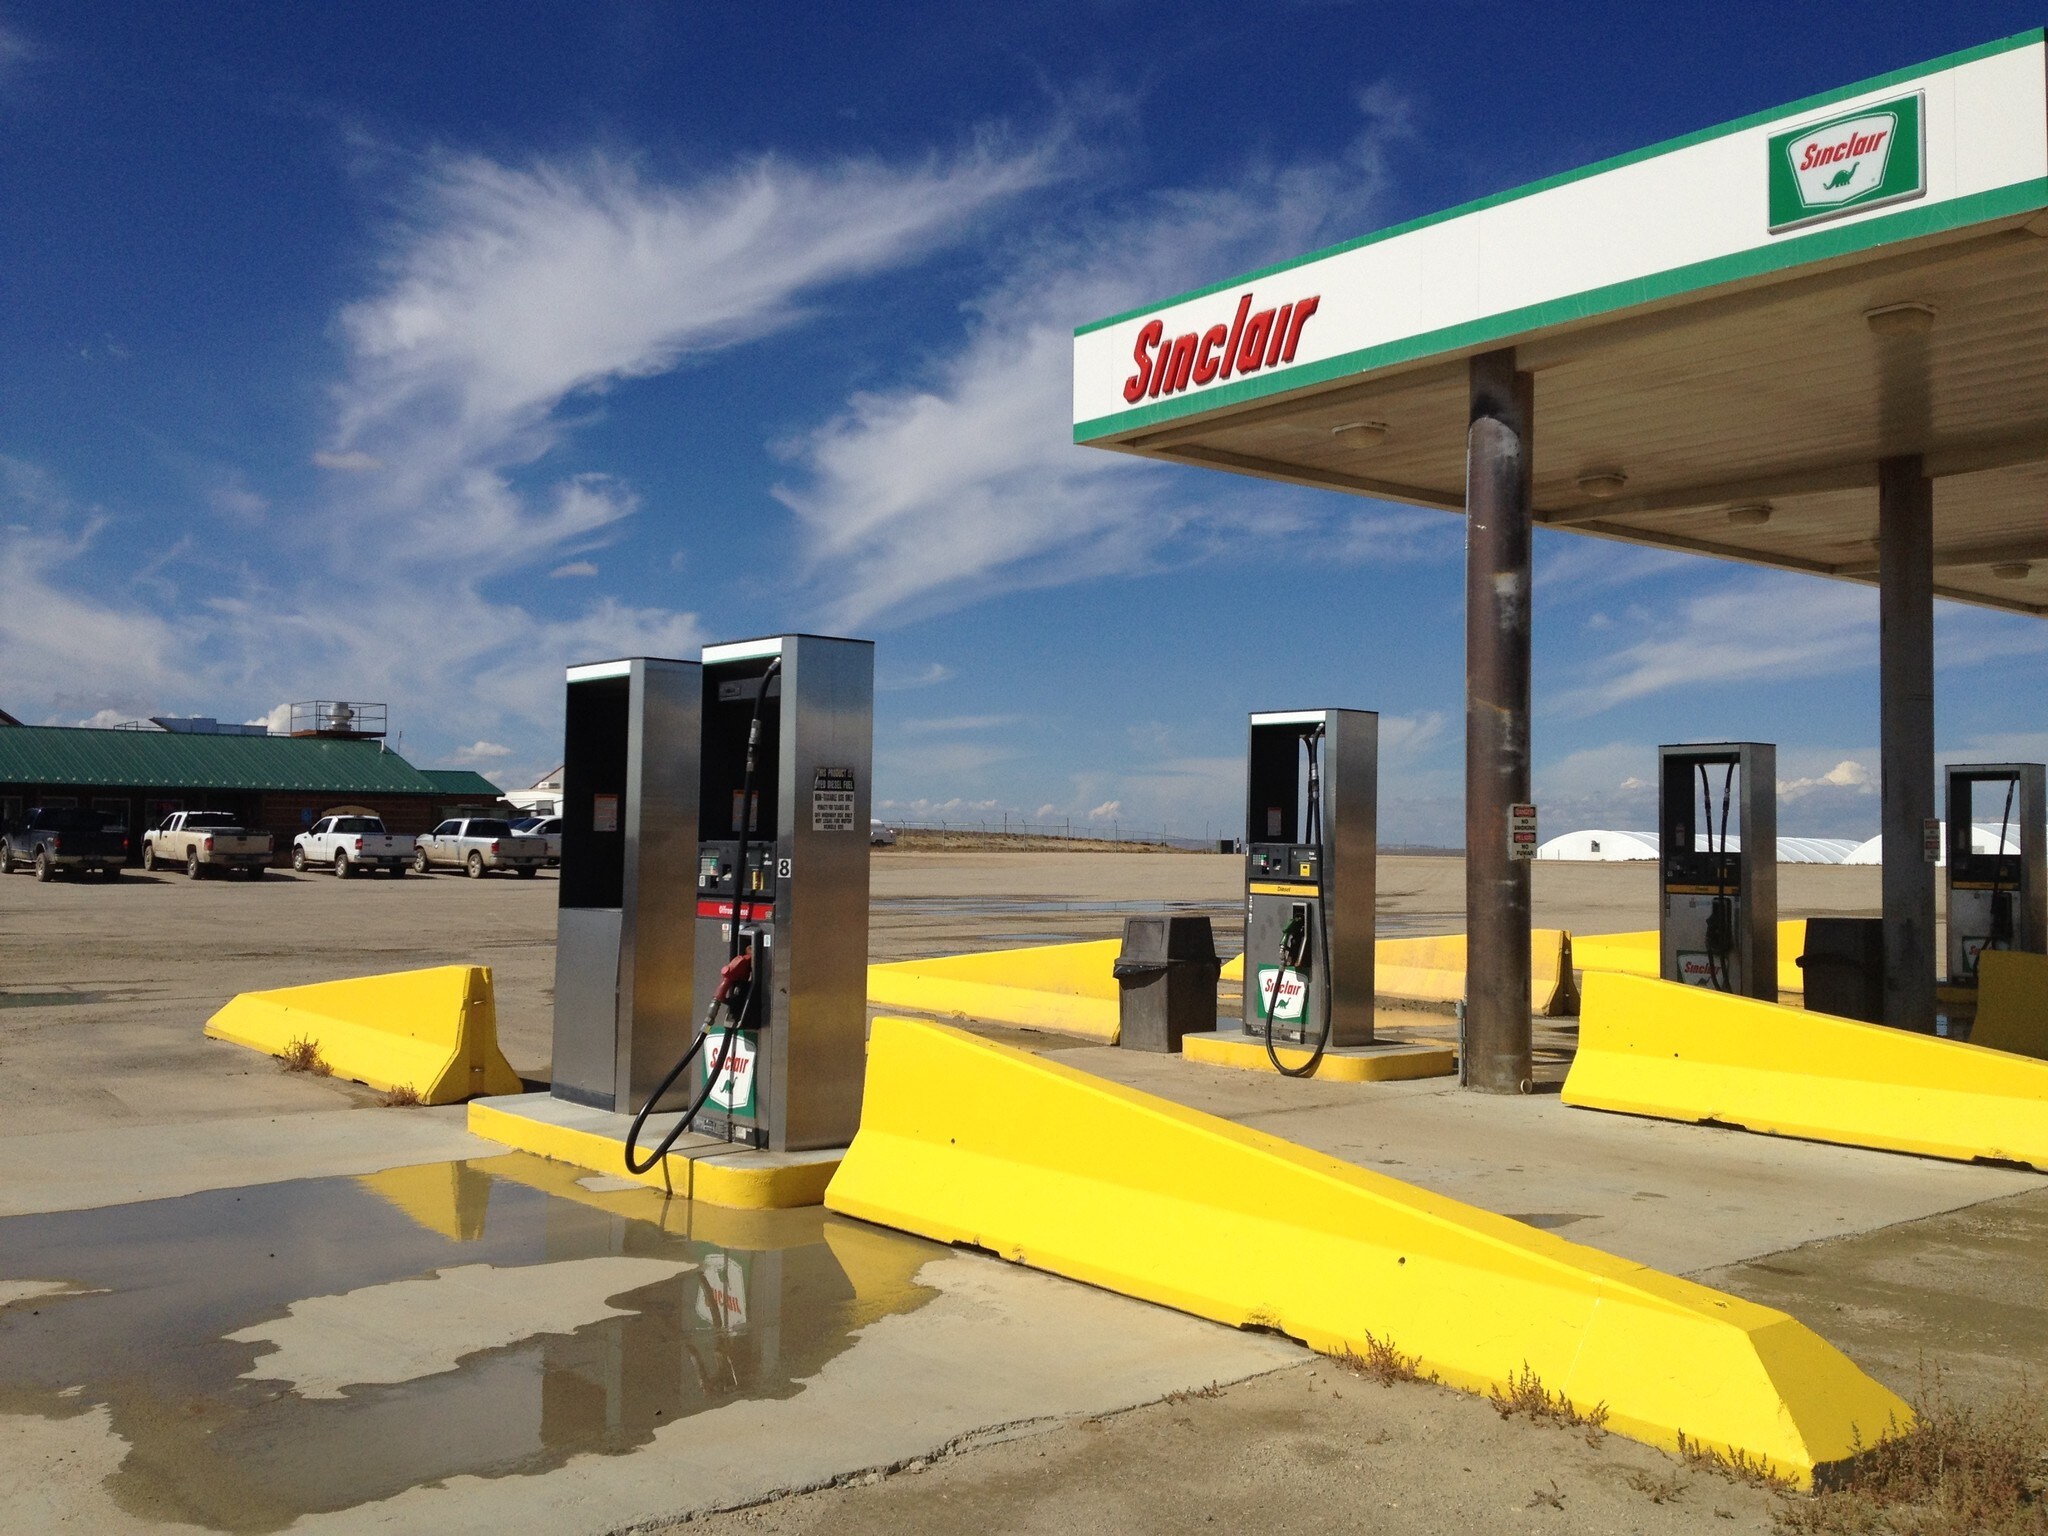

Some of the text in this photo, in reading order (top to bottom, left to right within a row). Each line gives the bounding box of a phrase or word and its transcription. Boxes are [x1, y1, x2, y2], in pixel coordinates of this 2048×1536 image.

[1801, 130, 1887, 171] Sinclair
[1123, 293, 1320, 404] Sinclair
[780, 860, 789, 877] 8
[1265, 978, 1302, 996] Siclair
[710, 1047, 750, 1074] Sclair
